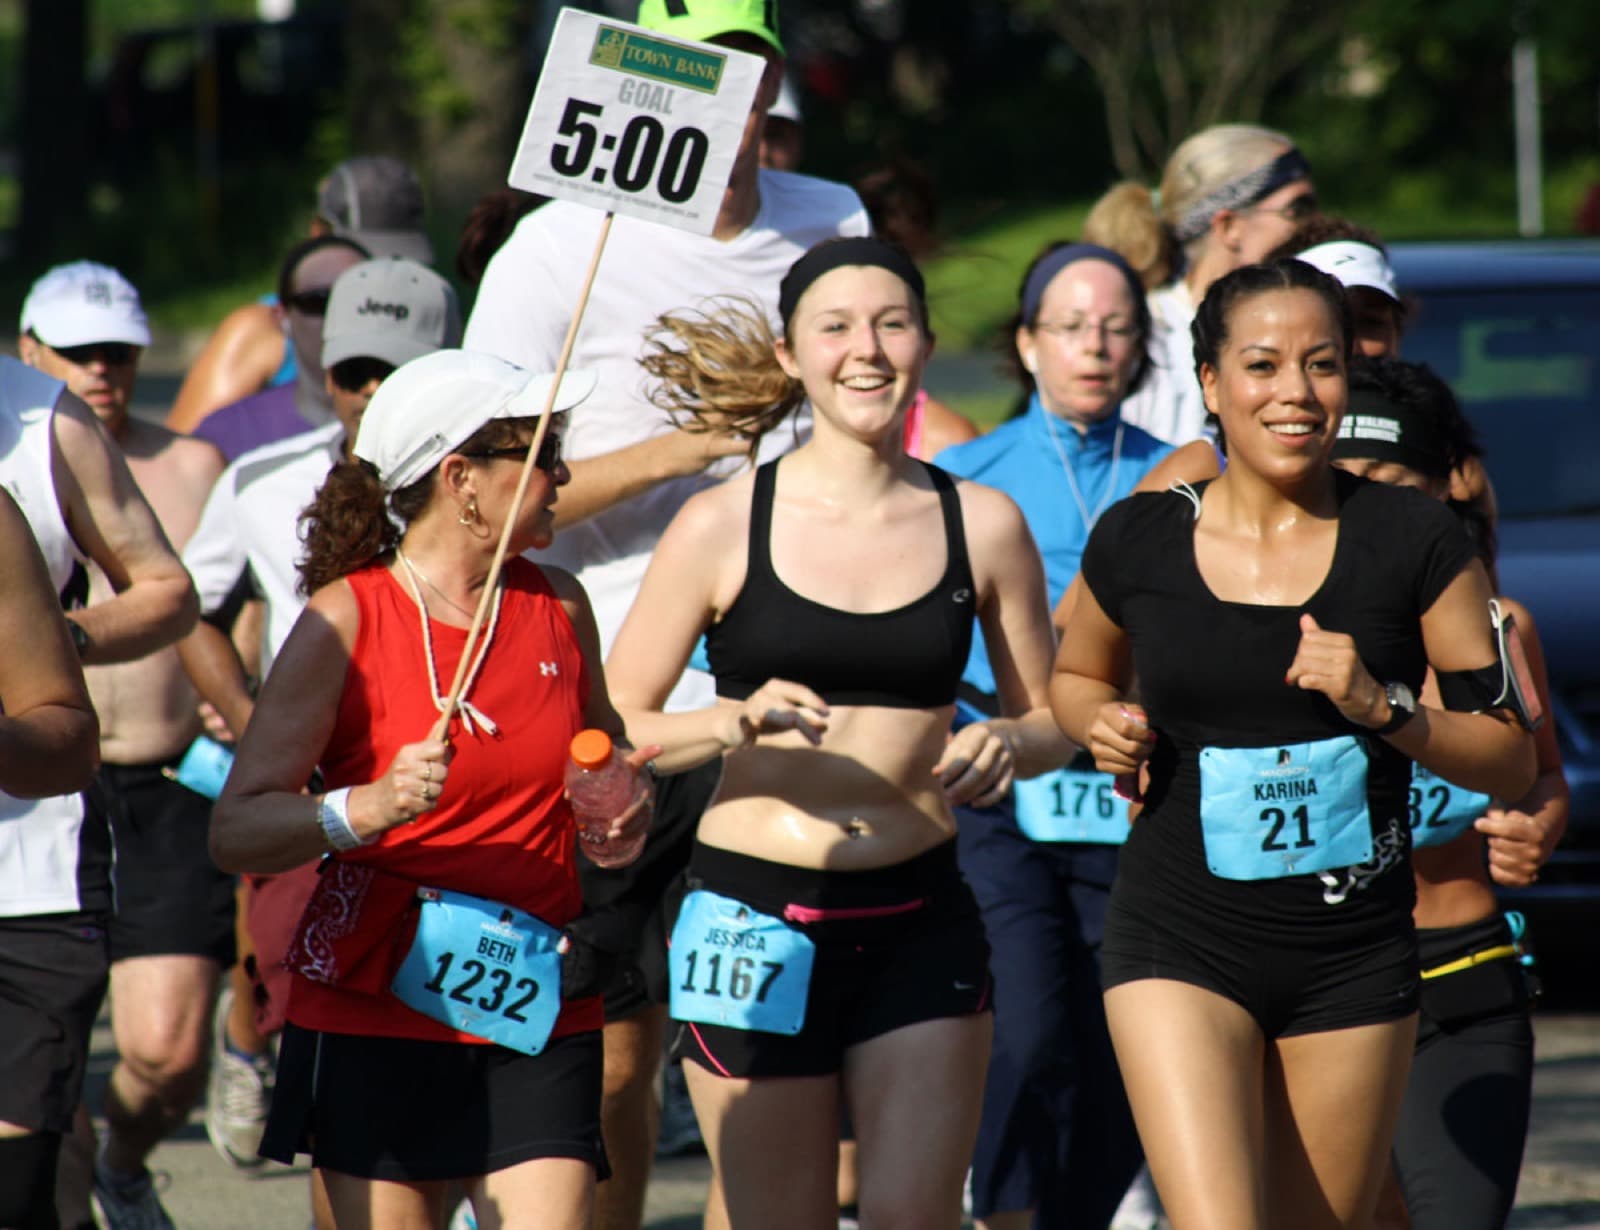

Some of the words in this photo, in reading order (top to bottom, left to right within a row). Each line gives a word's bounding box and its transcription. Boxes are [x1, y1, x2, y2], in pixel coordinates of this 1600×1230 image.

[625, 45, 671, 69] TOWN
[676, 58, 720, 82] BANK
[618, 77, 674, 115] GOAL
[550, 97, 709, 204] 5:00
[358, 298, 409, 321] Jeep
[1051, 780, 1114, 819] 176
[1254, 778, 1318, 801] KARINA
[1259, 804, 1315, 852] 21
[477, 936, 518, 965] BETH
[424, 952, 540, 1024] 1232
[681, 949, 785, 1004] 1167
